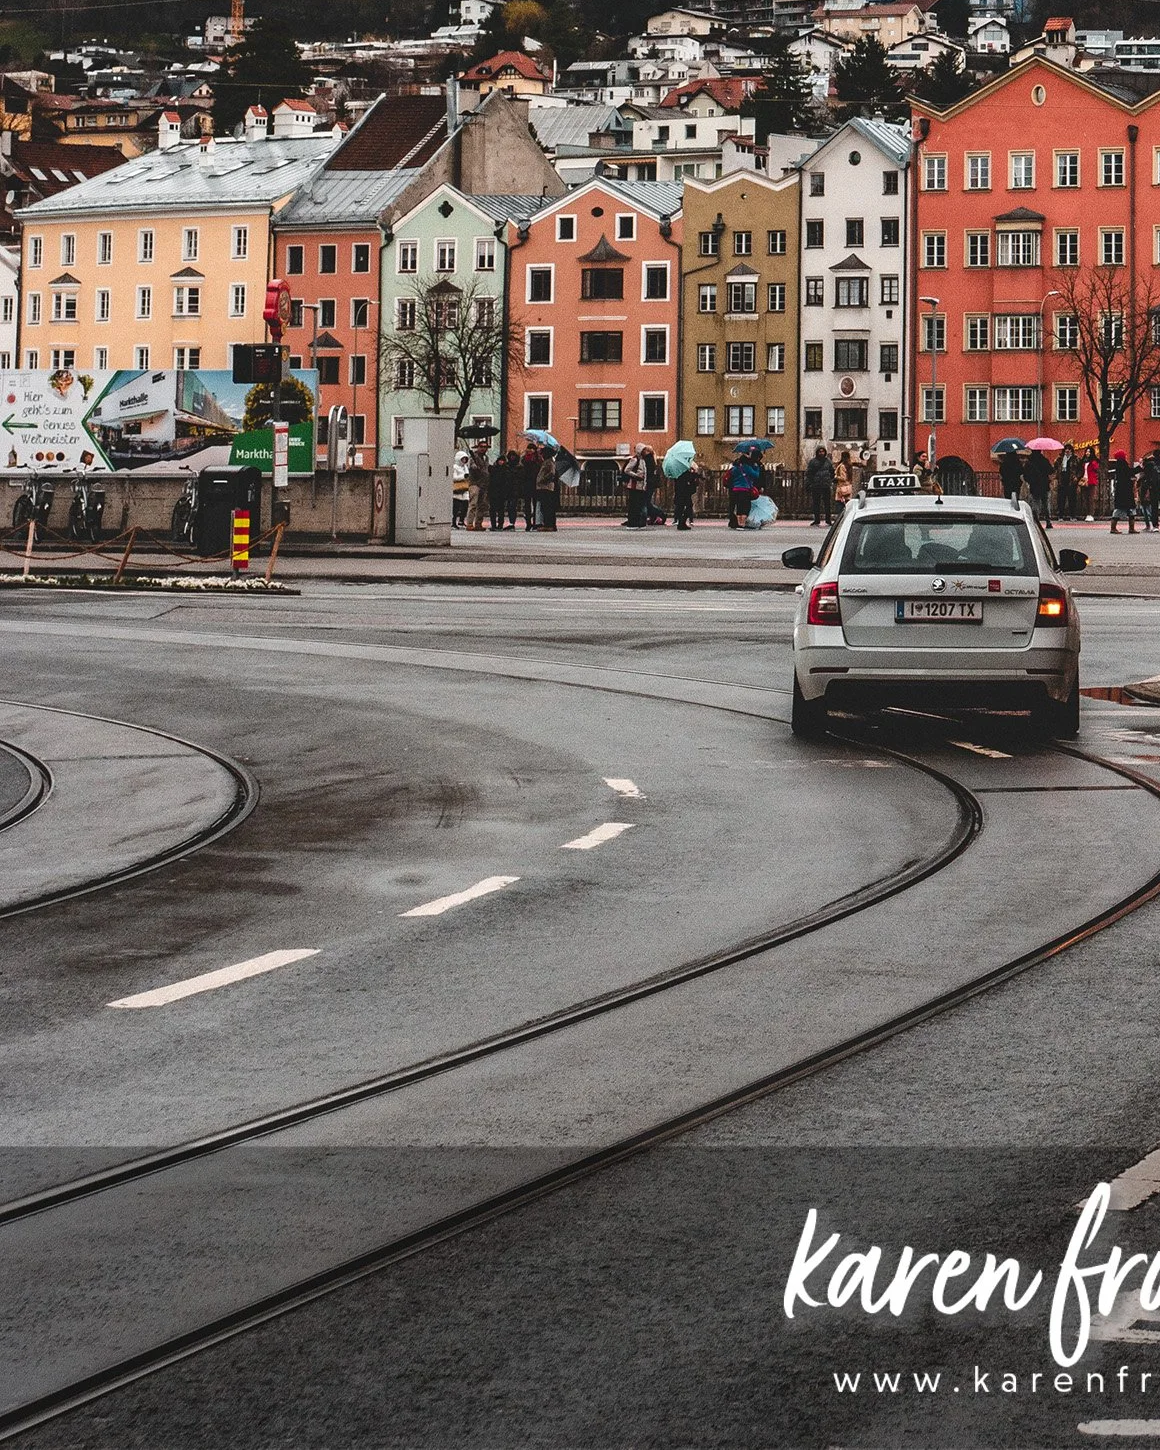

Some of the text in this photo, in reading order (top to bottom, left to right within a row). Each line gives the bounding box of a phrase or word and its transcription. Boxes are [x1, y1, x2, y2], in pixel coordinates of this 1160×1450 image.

[24, 391, 43, 402] Hier
[53, 407, 73, 415] zum
[236, 449, 273, 459] Marktha
[878, 478, 911, 487] TAXI
[925, 602, 954, 616] 1207
[960, 603, 976, 616] TX
